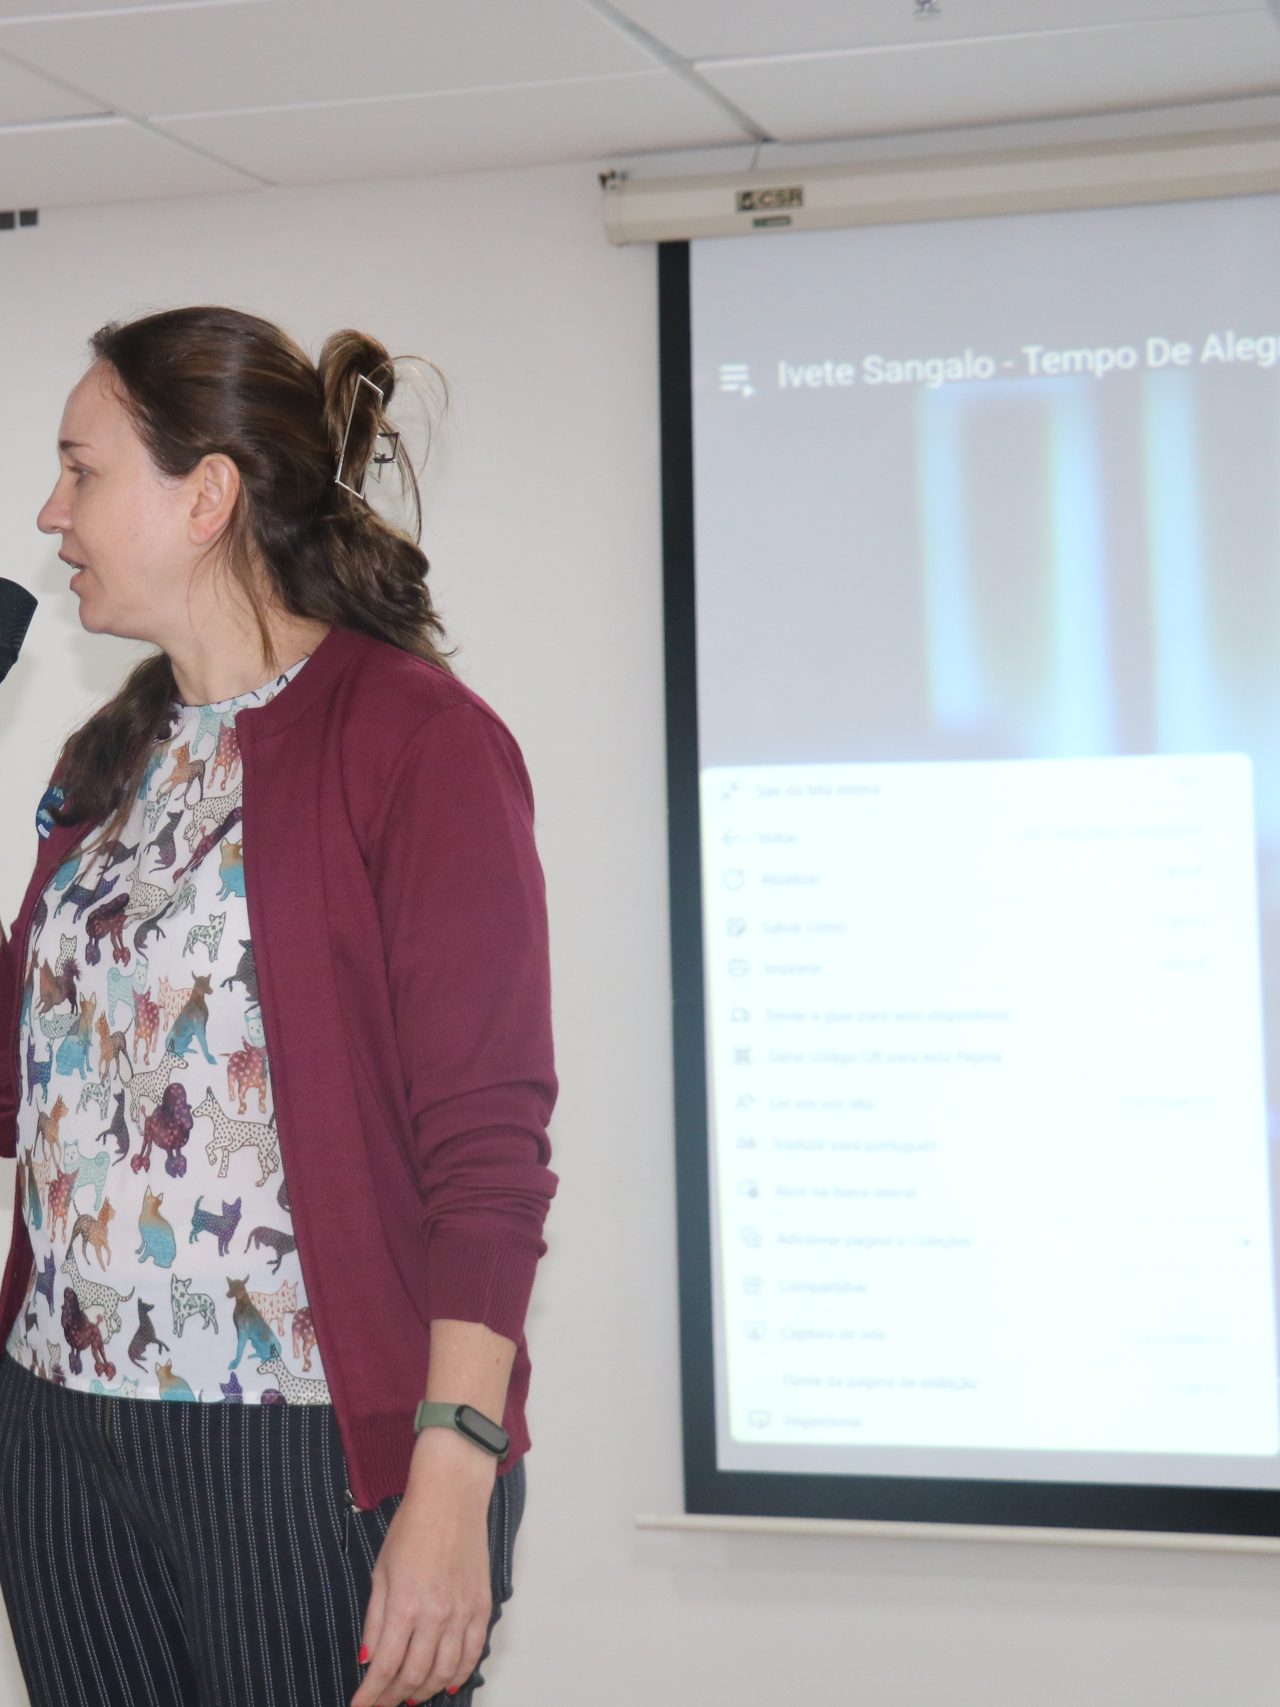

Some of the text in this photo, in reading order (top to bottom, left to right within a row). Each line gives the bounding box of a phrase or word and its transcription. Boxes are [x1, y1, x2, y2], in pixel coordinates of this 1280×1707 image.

[777, 359, 855, 389] Ivete
[862, 349, 995, 389] Sangalo
[1022, 344, 1138, 379] Tempo
[1146, 336, 1192, 368] De
